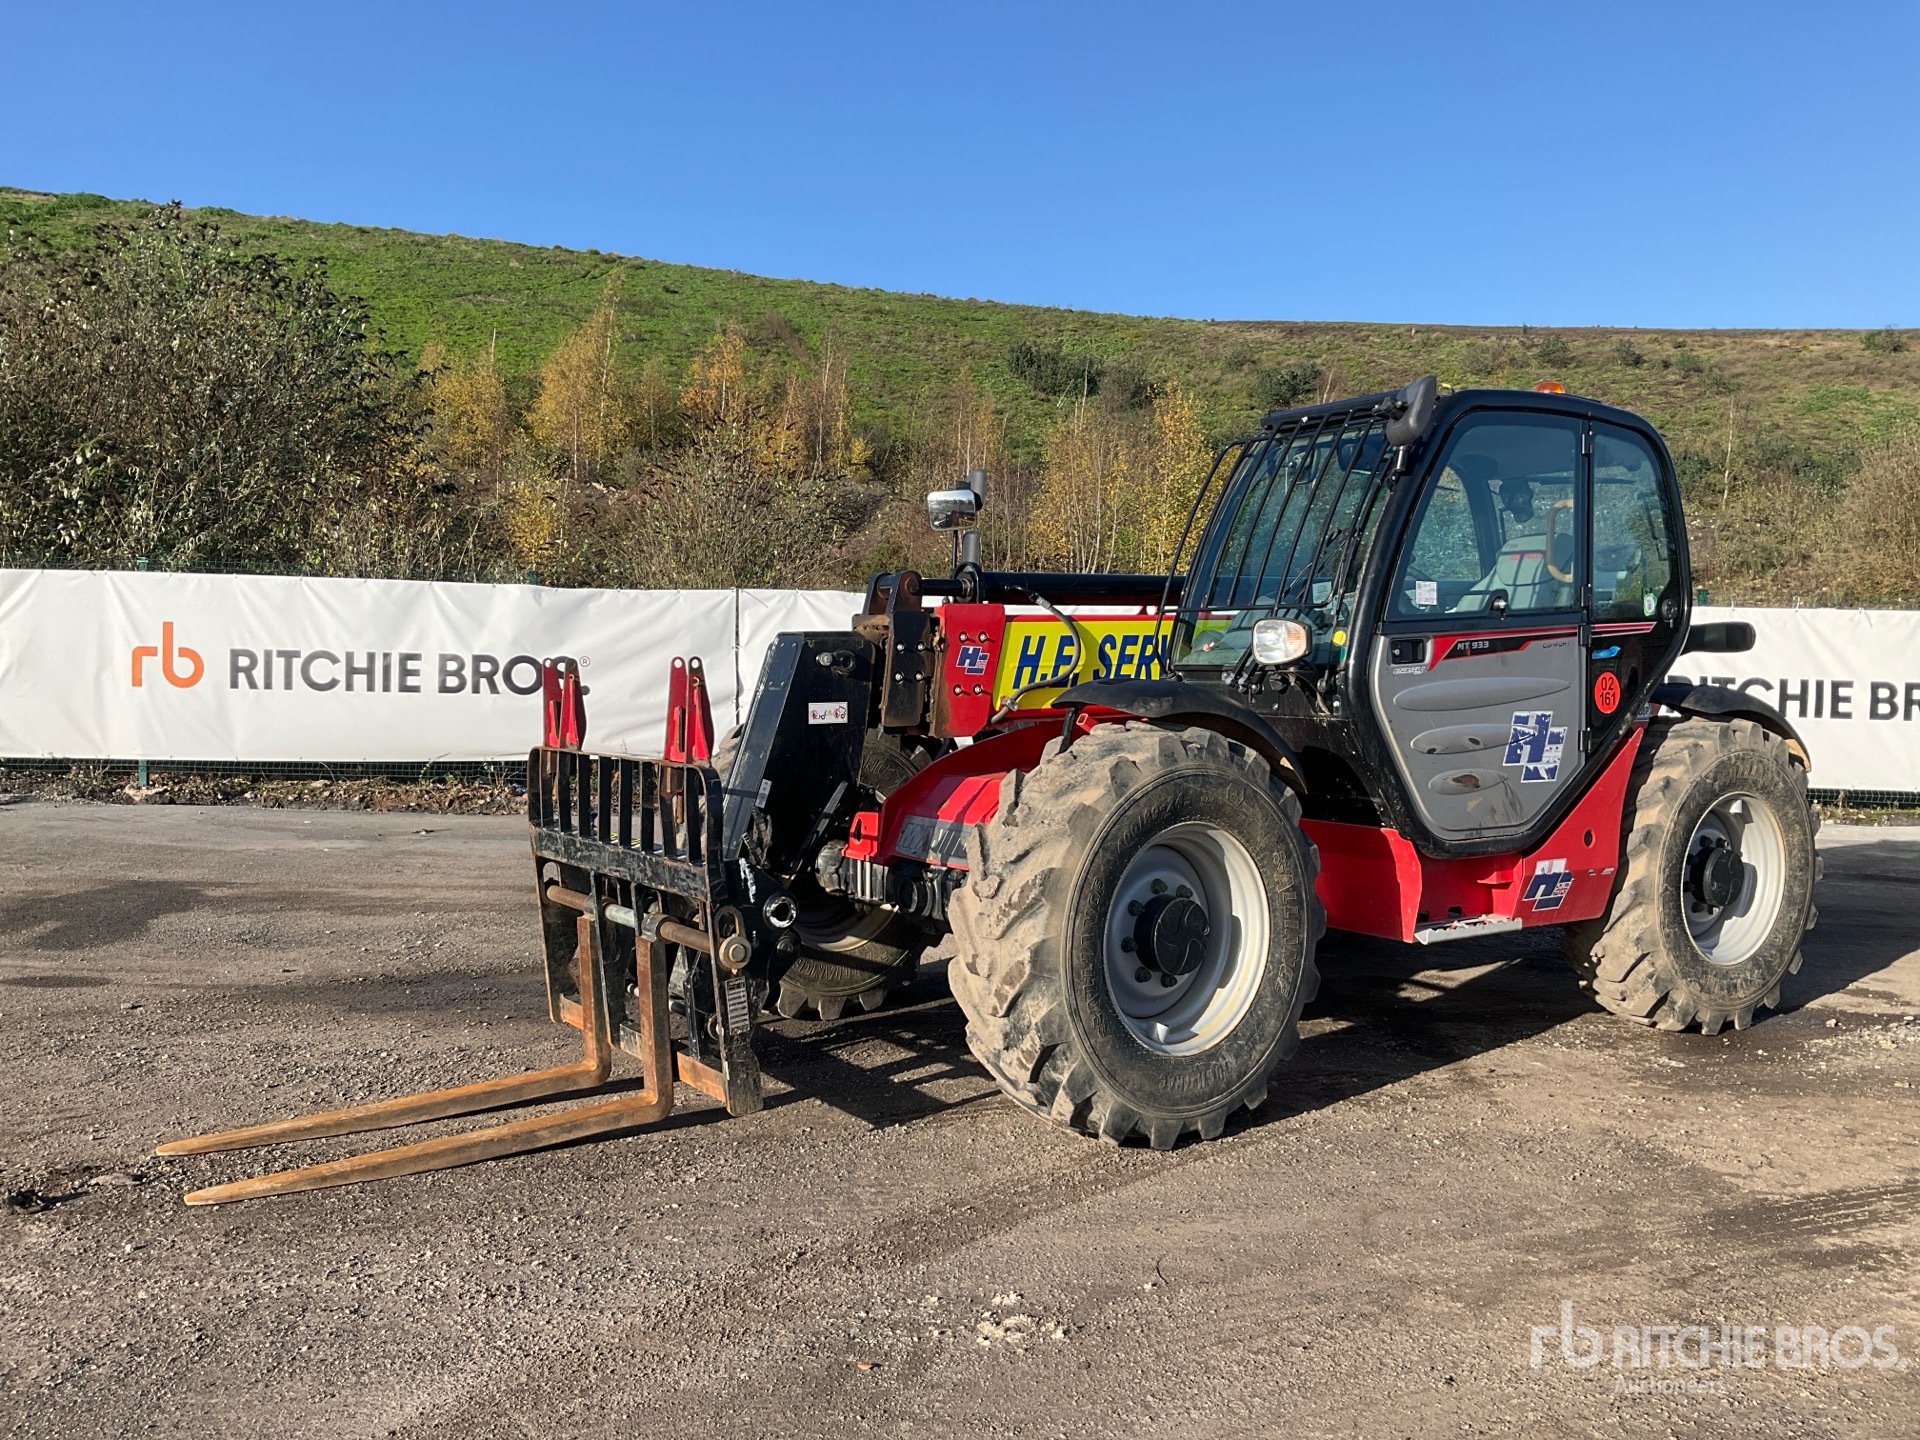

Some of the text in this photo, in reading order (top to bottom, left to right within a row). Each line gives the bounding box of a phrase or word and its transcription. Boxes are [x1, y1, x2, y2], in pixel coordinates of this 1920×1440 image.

[1457, 641, 1489, 650] MT 933
[229, 648, 421, 693] RITCHIE
[1601, 677, 1614, 690] 02
[1599, 692, 1617, 707] 161
